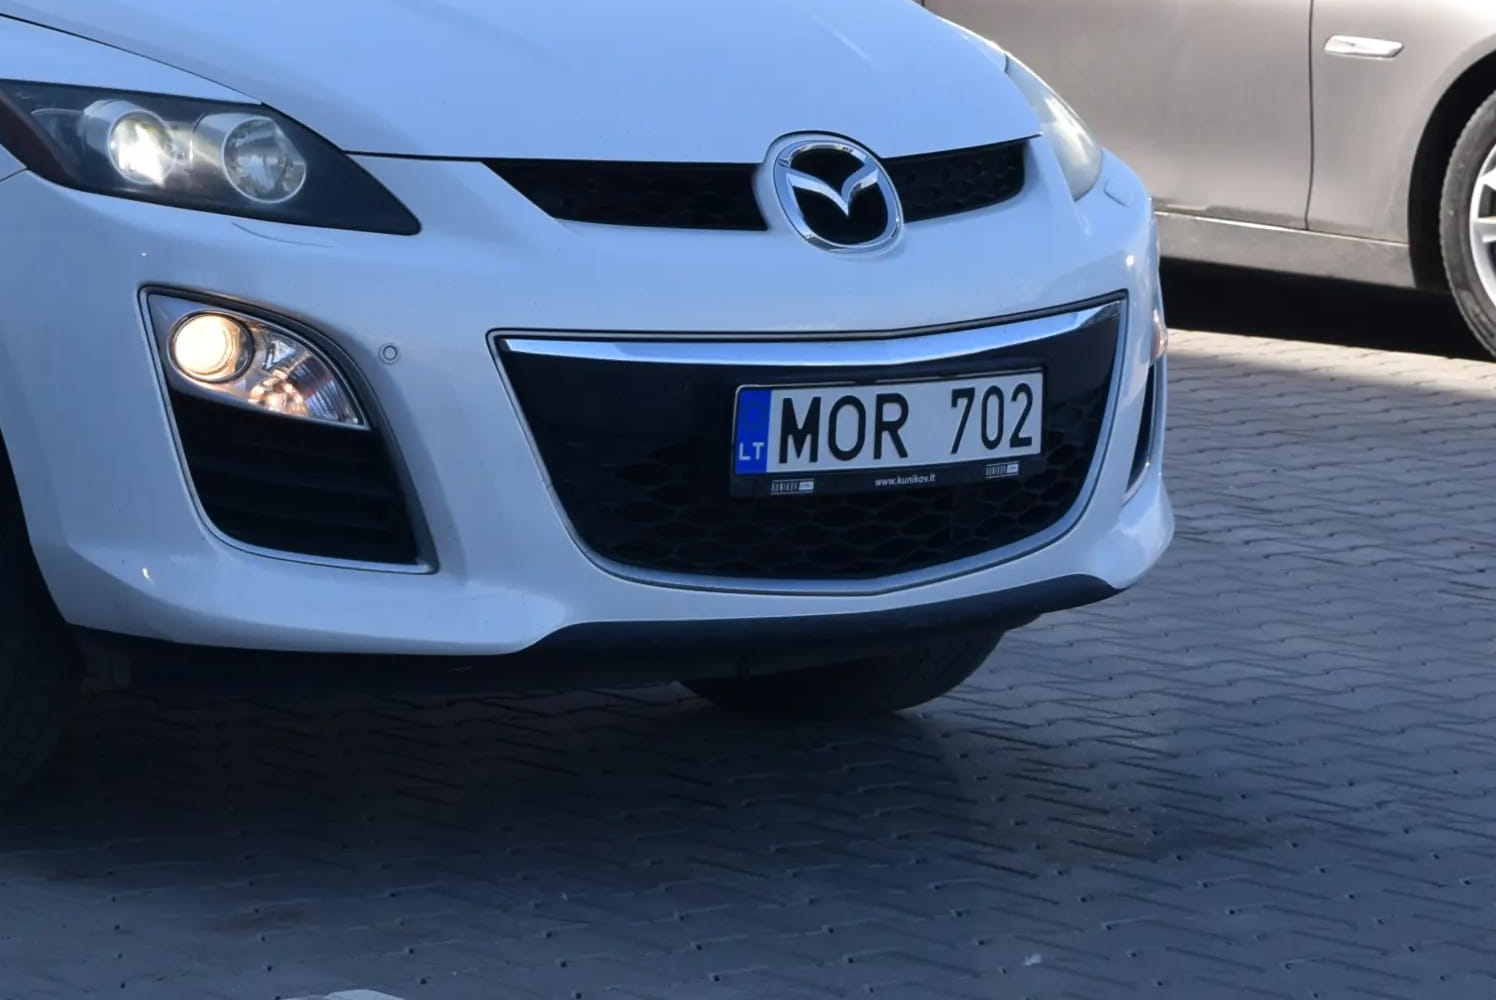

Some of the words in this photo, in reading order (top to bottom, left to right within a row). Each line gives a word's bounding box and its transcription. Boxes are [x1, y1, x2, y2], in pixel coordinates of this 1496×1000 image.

[778, 393, 909, 464] MOR
[950, 383, 1034, 455] 702
[738, 442, 764, 461] LT
[875, 473, 936, 486] www.kunikov.lt
